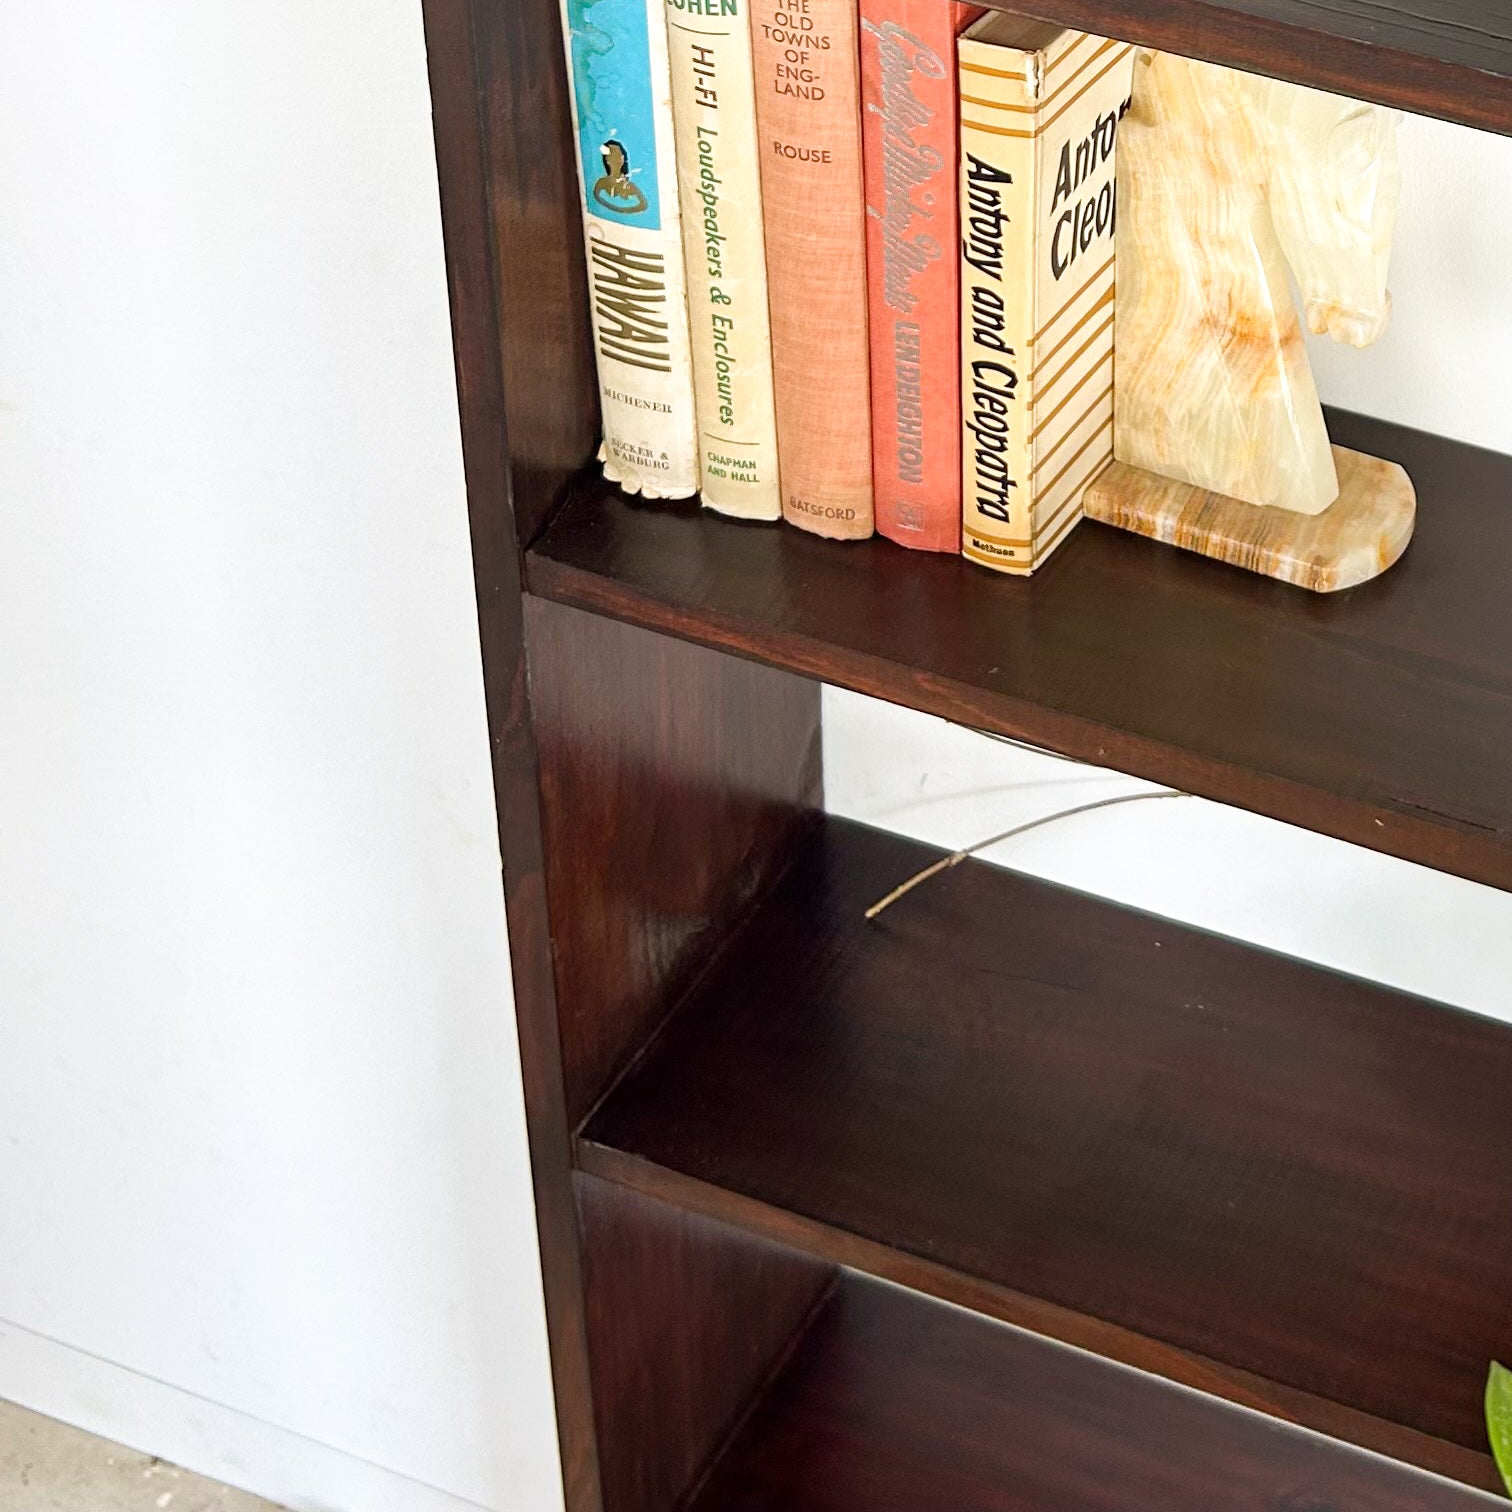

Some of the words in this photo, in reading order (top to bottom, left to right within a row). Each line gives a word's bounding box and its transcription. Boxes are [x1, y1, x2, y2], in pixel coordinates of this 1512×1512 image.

[775, 12, 813, 31] OLD
[762, 25, 831, 50] TOWNS
[785, 50, 810, 65] OF
[691, 44, 718, 109] HI-FI
[776, 64, 820, 83] ENG-
[774, 80, 825, 101] LAND
[774, 141, 832, 164] ROUSE
[696, 125, 727, 279] Loudspeakers
[963, 151, 1014, 282] Antony
[590, 236, 672, 372] HAWAII
[710, 286, 732, 306] &
[971, 286, 1016, 356] and
[895, 319, 921, 361] LEN
[712, 313, 737, 427] Enclosures
[603, 386, 672, 413] MICHENER
[896, 363, 924, 486] DEIGHTON
[965, 360, 1019, 524] Cleopatra
[612, 447, 671, 470] WARBURG
[660, 451, 669, 461] &
[707, 451, 756, 470] CHAPMAN
[707, 463, 727, 479] AND
[731, 469, 760, 483] HALL
[789, 495, 856, 521] BATSFORD
